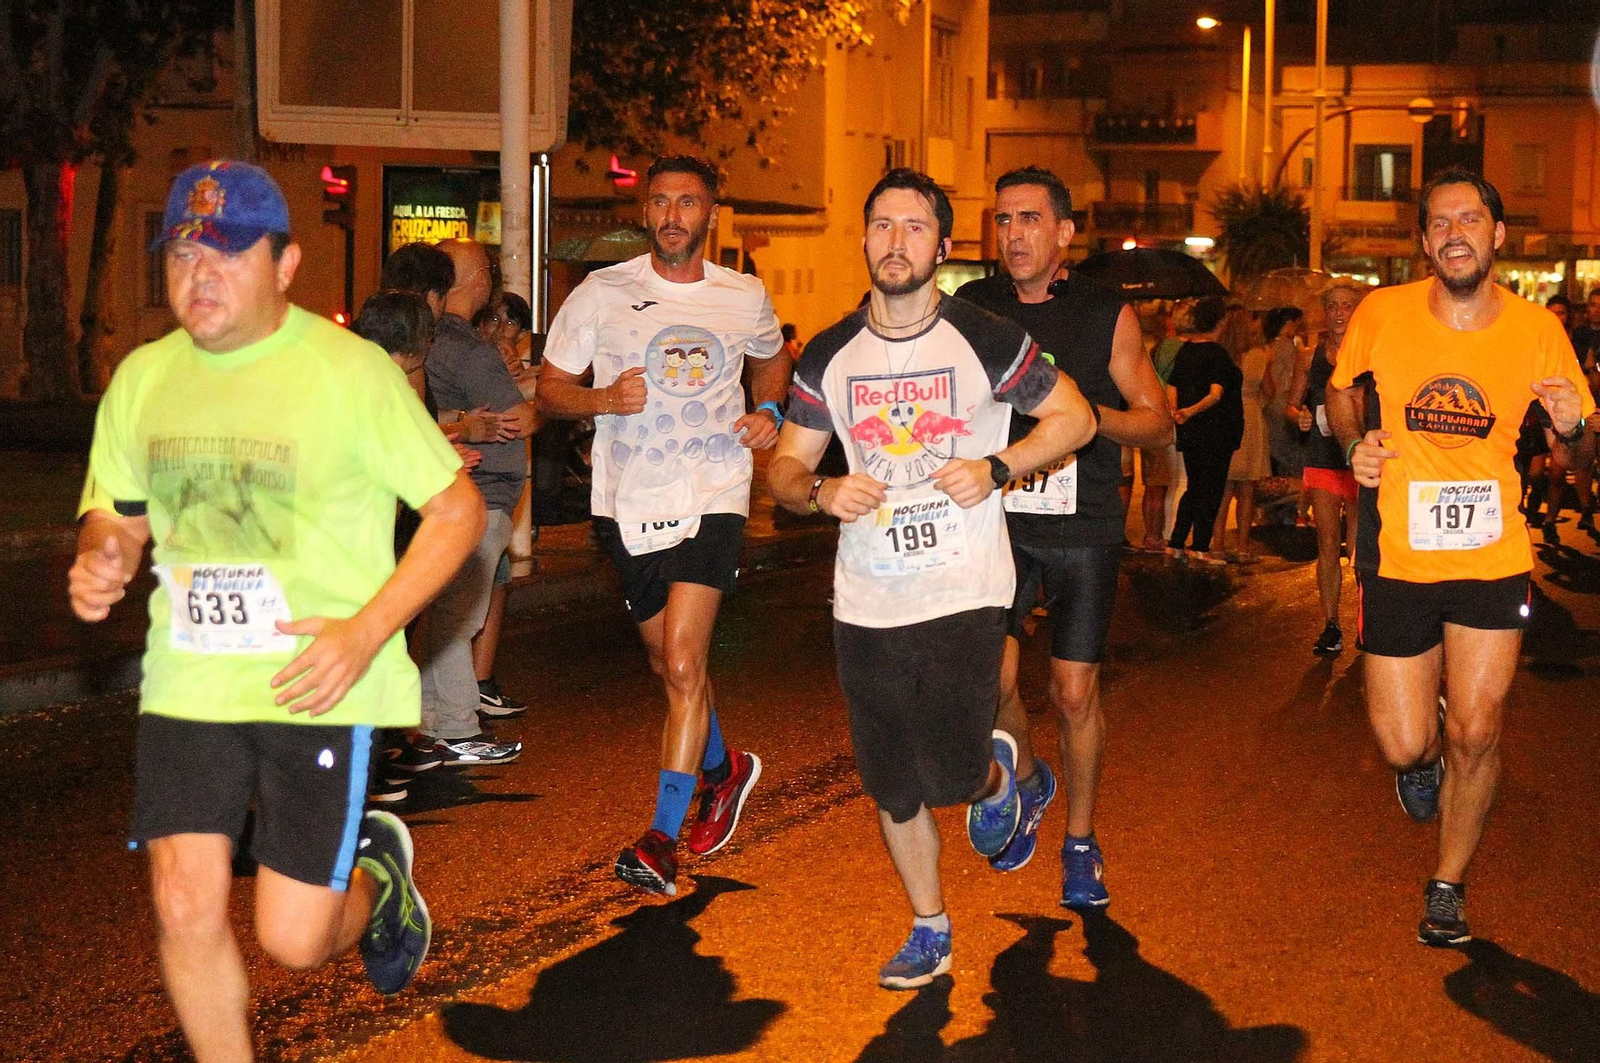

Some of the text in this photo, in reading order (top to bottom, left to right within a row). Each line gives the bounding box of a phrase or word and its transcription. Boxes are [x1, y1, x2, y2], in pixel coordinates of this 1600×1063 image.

[416, 205, 423, 217] A
[423, 205, 434, 217] LA
[392, 218, 468, 239] CRUZCAMPO
[854, 376, 948, 407] Red Bull
[1418, 421, 1477, 433] CAPILEIRA
[1427, 413, 1488, 428] ALPUJARRA
[865, 446, 947, 482] NEW YORK
[1437, 494, 1490, 504] DE HUELVA
[1440, 485, 1492, 495] NOCTURNA
[892, 499, 950, 518] NOCTURNA
[1429, 504, 1475, 529] 197
[891, 509, 949, 527] DE HUELVA
[885, 522, 938, 552] 199
[193, 567, 265, 579] NOCTURNA
[213, 579, 264, 591] HUELVA
[188, 590, 248, 625] 633
